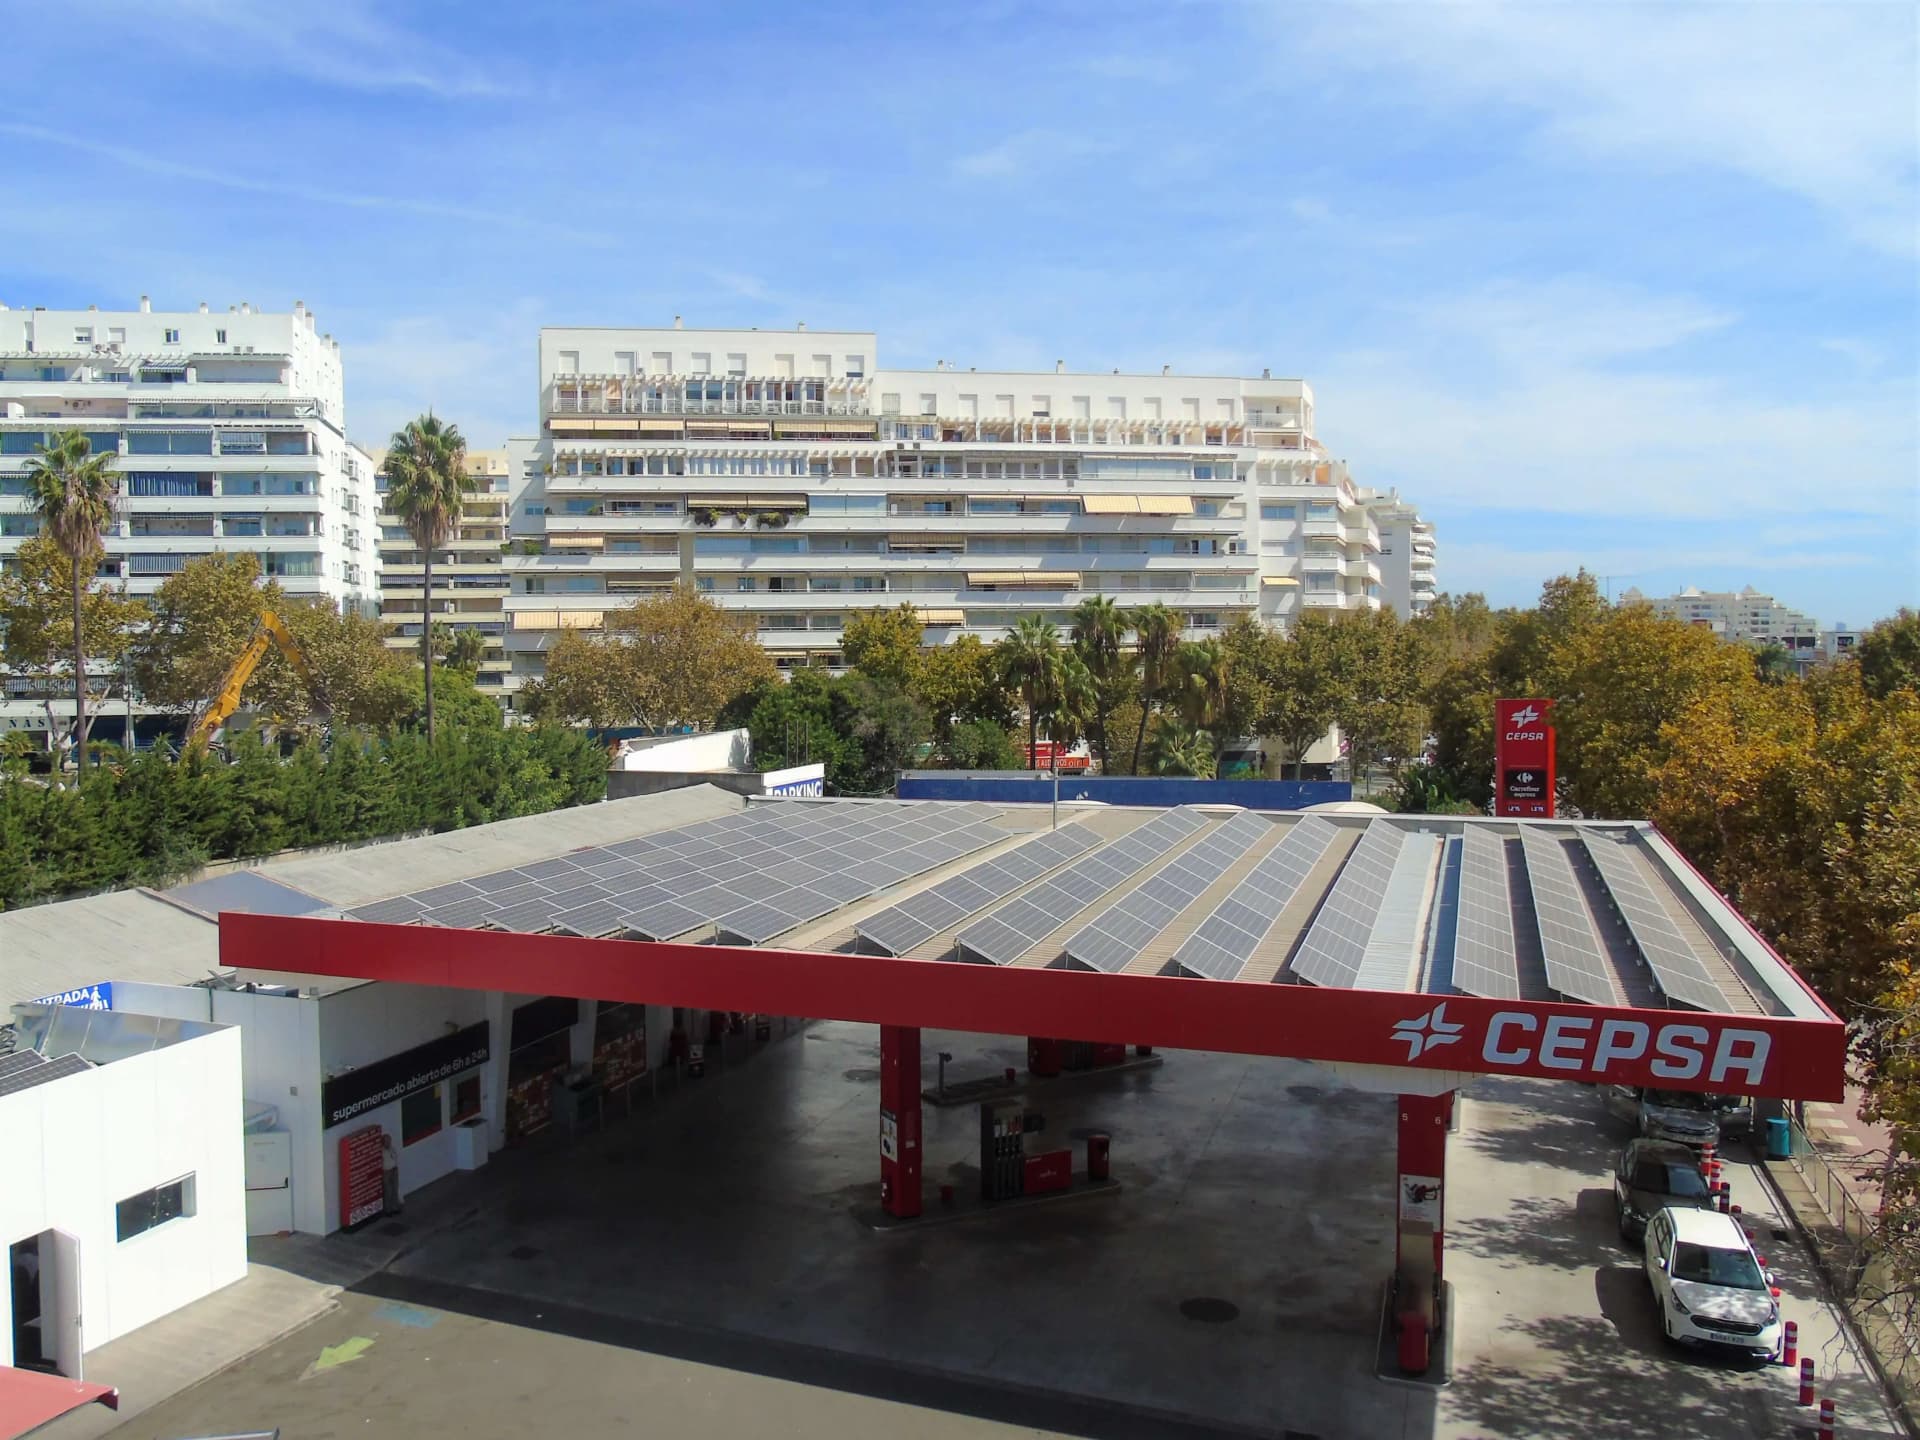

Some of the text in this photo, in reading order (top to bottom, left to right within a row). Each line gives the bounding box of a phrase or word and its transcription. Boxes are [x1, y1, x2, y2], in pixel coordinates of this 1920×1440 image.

[1505, 732, 1544, 741] CEPSA
[33, 988, 90, 1006] TRADA
[1482, 1011, 1772, 1086] CEPSA
[332, 1082, 405, 1121] supermercado
[406, 1069, 440, 1090] abierto
[440, 1063, 452, 1076] de
